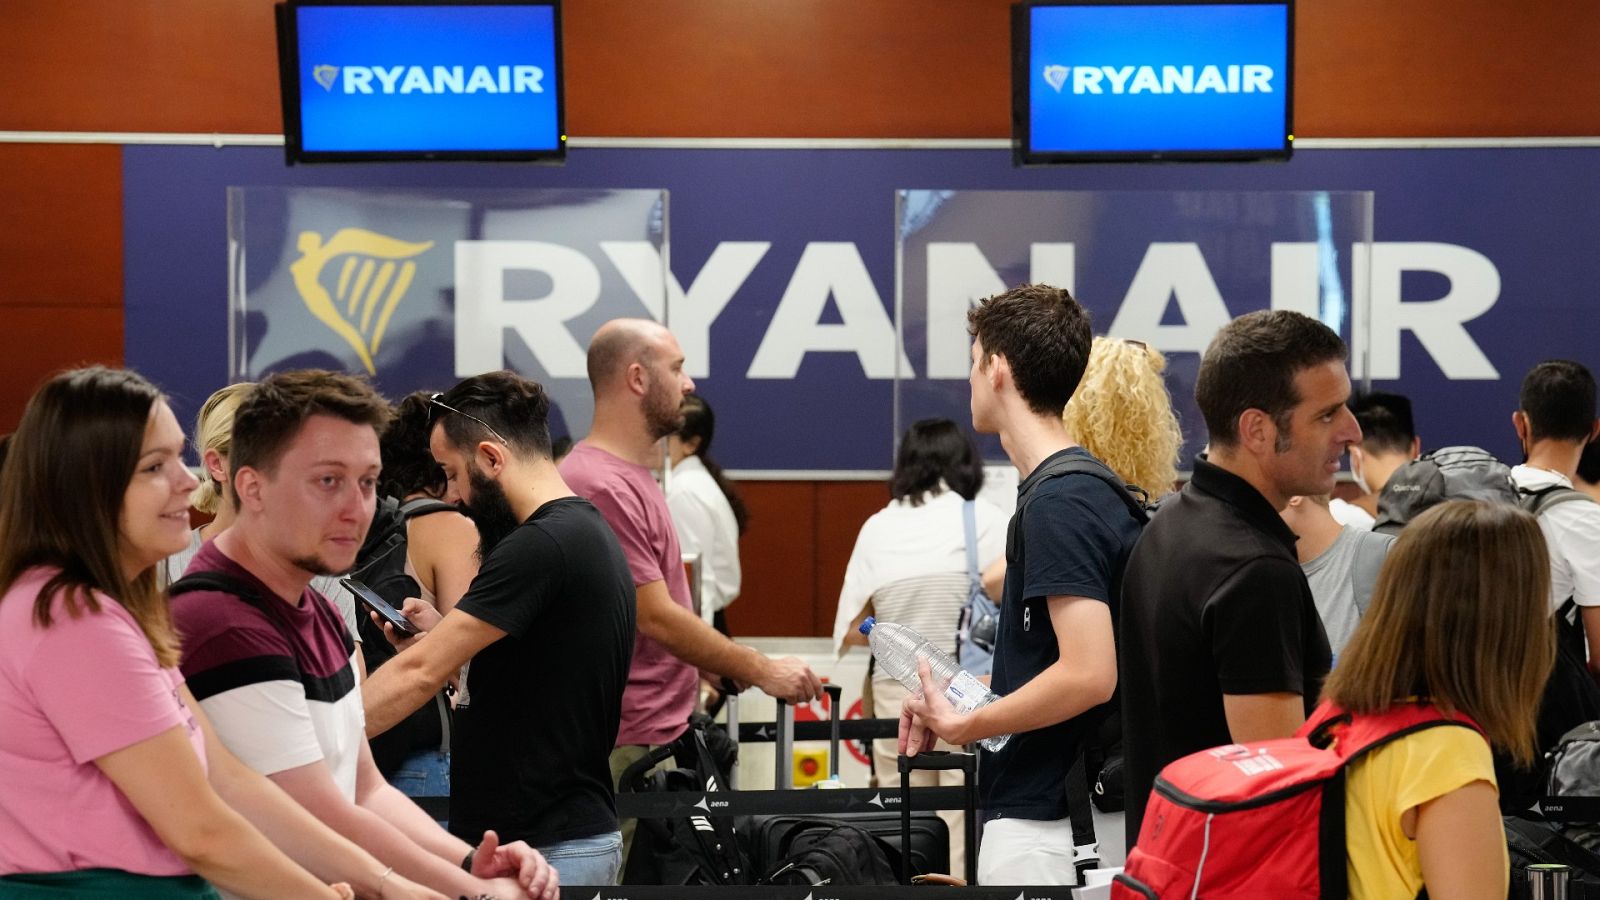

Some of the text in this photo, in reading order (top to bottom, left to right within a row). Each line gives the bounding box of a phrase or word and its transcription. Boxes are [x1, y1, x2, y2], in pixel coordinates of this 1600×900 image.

[343, 65, 543, 94] RYANAIR
[1073, 64, 1274, 94] RYANAIR
[453, 241, 1502, 380] RYANAIR
